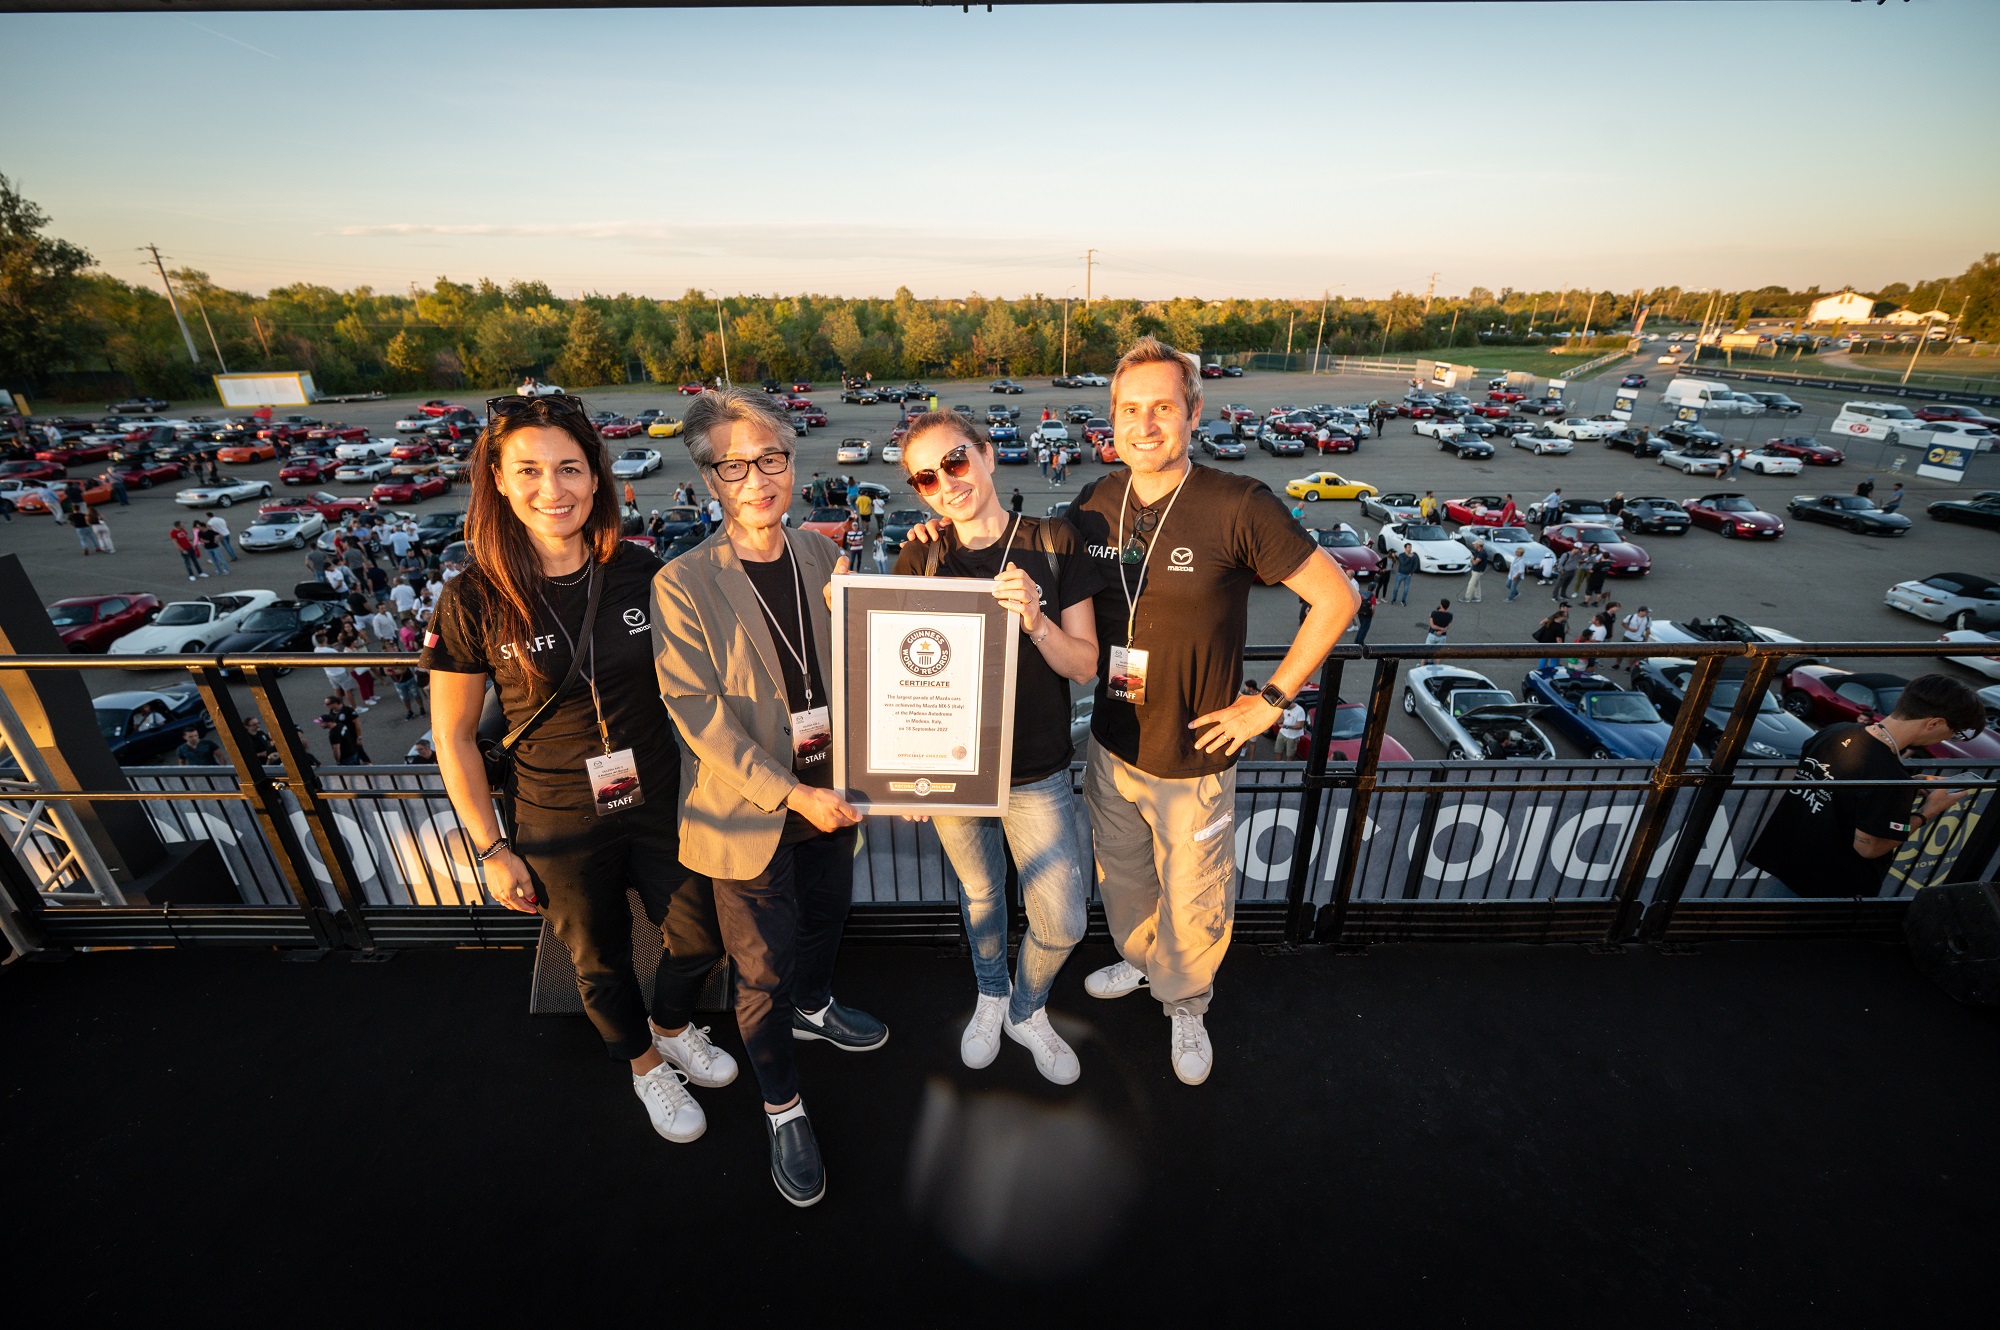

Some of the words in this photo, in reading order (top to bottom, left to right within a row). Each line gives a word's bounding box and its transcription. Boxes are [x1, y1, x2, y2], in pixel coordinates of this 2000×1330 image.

[906, 630, 945, 644] GUINNESS
[902, 648, 920, 672] WORLD
[922, 650, 948, 674] RECORDS
[1114, 690, 1136, 700] STAFF
[805, 752, 826, 764] STAFF
[607, 796, 634, 809] STAFF
